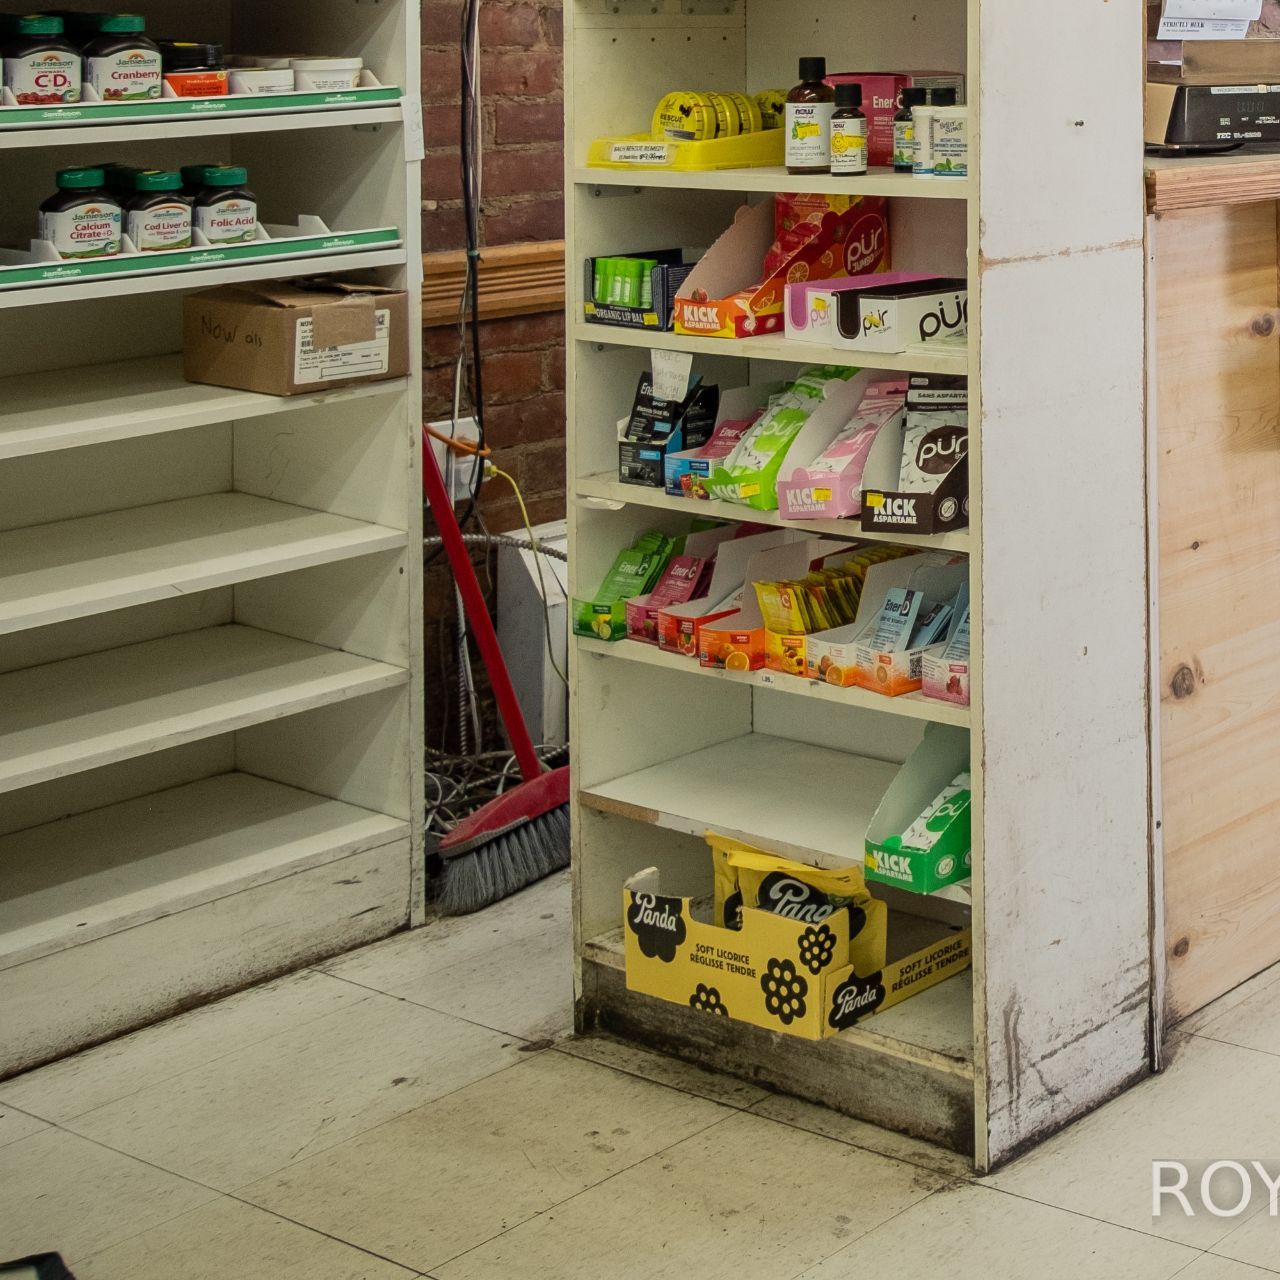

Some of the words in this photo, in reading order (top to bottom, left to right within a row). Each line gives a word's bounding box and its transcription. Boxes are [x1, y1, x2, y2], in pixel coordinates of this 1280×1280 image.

[1162, 21, 1188, 29] STRICTLY
[29, 59, 73, 68] Jamieson
[115, 58, 157, 66] Jamieson
[111, 70, 161, 81] Cranberry
[324, 94, 358, 103] Jamieson
[191, 102, 227, 111] Jamieson
[42, 109, 82, 119] Jamieson
[660, 113, 684, 122] RESCUE
[72, 211, 114, 221] Jamieson
[152, 210, 184, 218] Jamieson
[75, 222, 111, 231] Calcium
[144, 223, 161, 231] Cod
[162, 222, 181, 230] Liver
[210, 218, 234, 228] Folic
[235, 216, 255, 226] Acid
[322, 239, 355, 248] Jamieson
[190, 252, 226, 261] Jamieson
[852, 254, 876, 273] JUMBO
[42, 267, 81, 278] Jamieson
[596, 308, 622, 321] ORGANIC
[622, 312, 632, 321] LIP
[683, 304, 719, 323] KICK
[202, 315, 238, 344] NOW
[684, 320, 720, 330] ASPARTAME
[788, 504, 825, 512] ASPARTAME
[873, 498, 916, 517] KICK
[873, 515, 917, 524] ASPARTAME
[670, 564, 697, 579] Ener-C
[873, 851, 911, 875] KICK
[634, 892, 679, 932] Panda
[695, 943, 714, 956] SOFT
[716, 947, 750, 966] LICORICE
[899, 959, 921, 978] SOFT
[922, 938, 963, 966] LICORICE
[690, 952, 724, 971] RÉGLISSE
[725, 961, 757, 979] TENDRE
[891, 969, 930, 993] RÉGLISSE
[933, 947, 970, 974] TENDRE
[835, 983, 878, 1020] Panda
